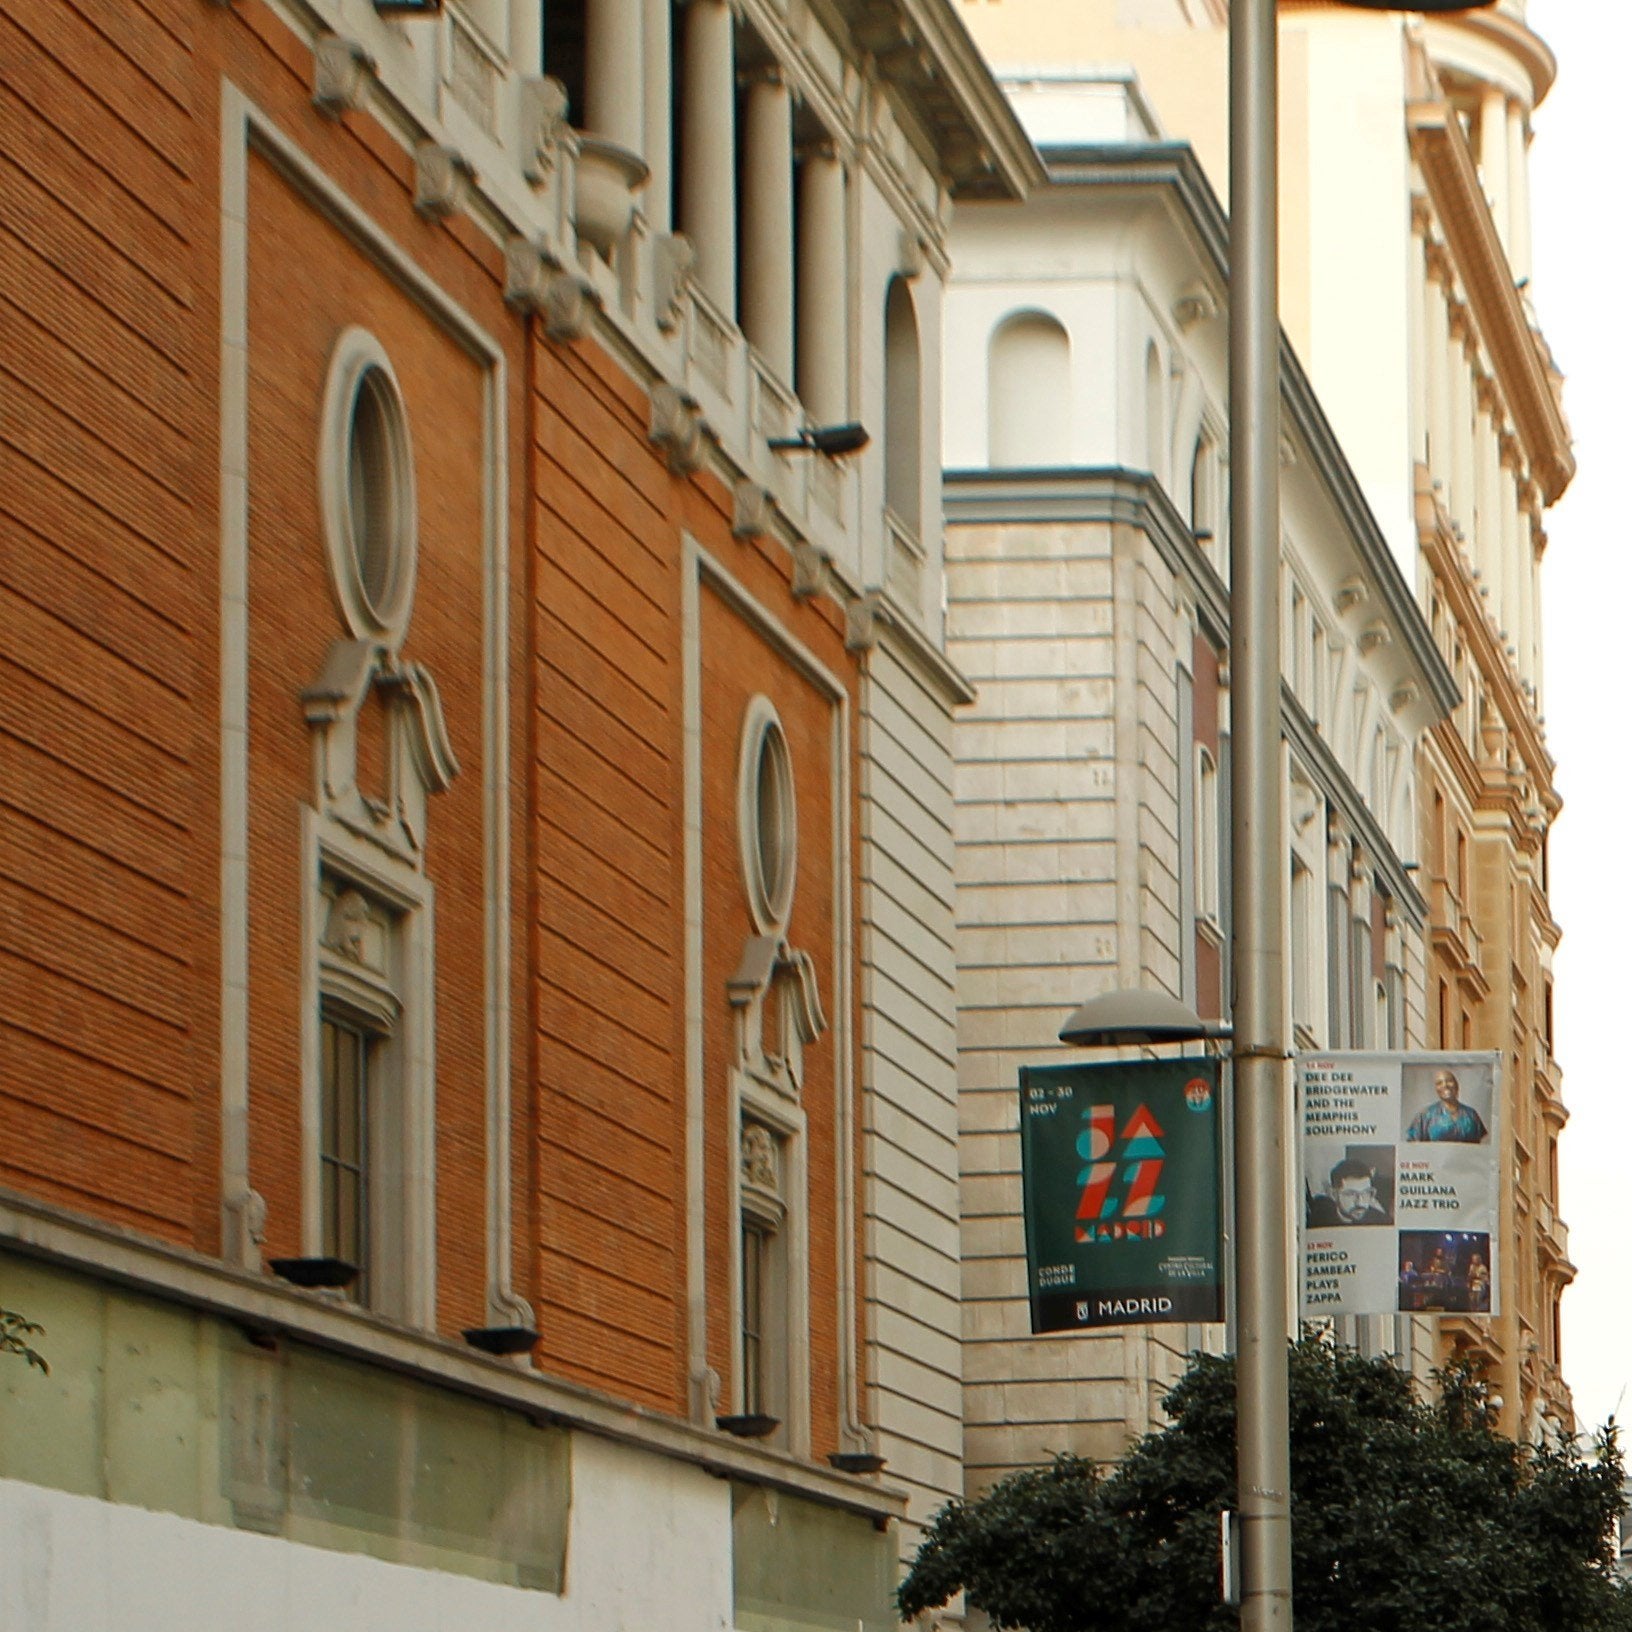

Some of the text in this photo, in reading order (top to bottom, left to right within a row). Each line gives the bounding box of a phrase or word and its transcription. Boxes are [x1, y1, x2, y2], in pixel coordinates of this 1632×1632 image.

[1305, 1072, 1353, 1082] DEE DEE
[1305, 1085, 1388, 1096] BRIDGEWATER
[1030, 1103, 1058, 1115] NOV
[1306, 1099, 1354, 1109] AND THE
[1306, 1112, 1359, 1122] MEMPHIS
[1306, 1125, 1377, 1136] SOULPHONY
[1401, 1172, 1434, 1182] MARK
[1401, 1186, 1456, 1196] GUILIANA
[1400, 1200, 1460, 1210] JAZZ TRIO
[1306, 1252, 1348, 1263] PERICO
[1306, 1264, 1356, 1276] SAMBEAT
[1306, 1280, 1339, 1290] PLAYS
[1306, 1293, 1342, 1304] ZAPPA
[1099, 1297, 1172, 1316] MADRID
